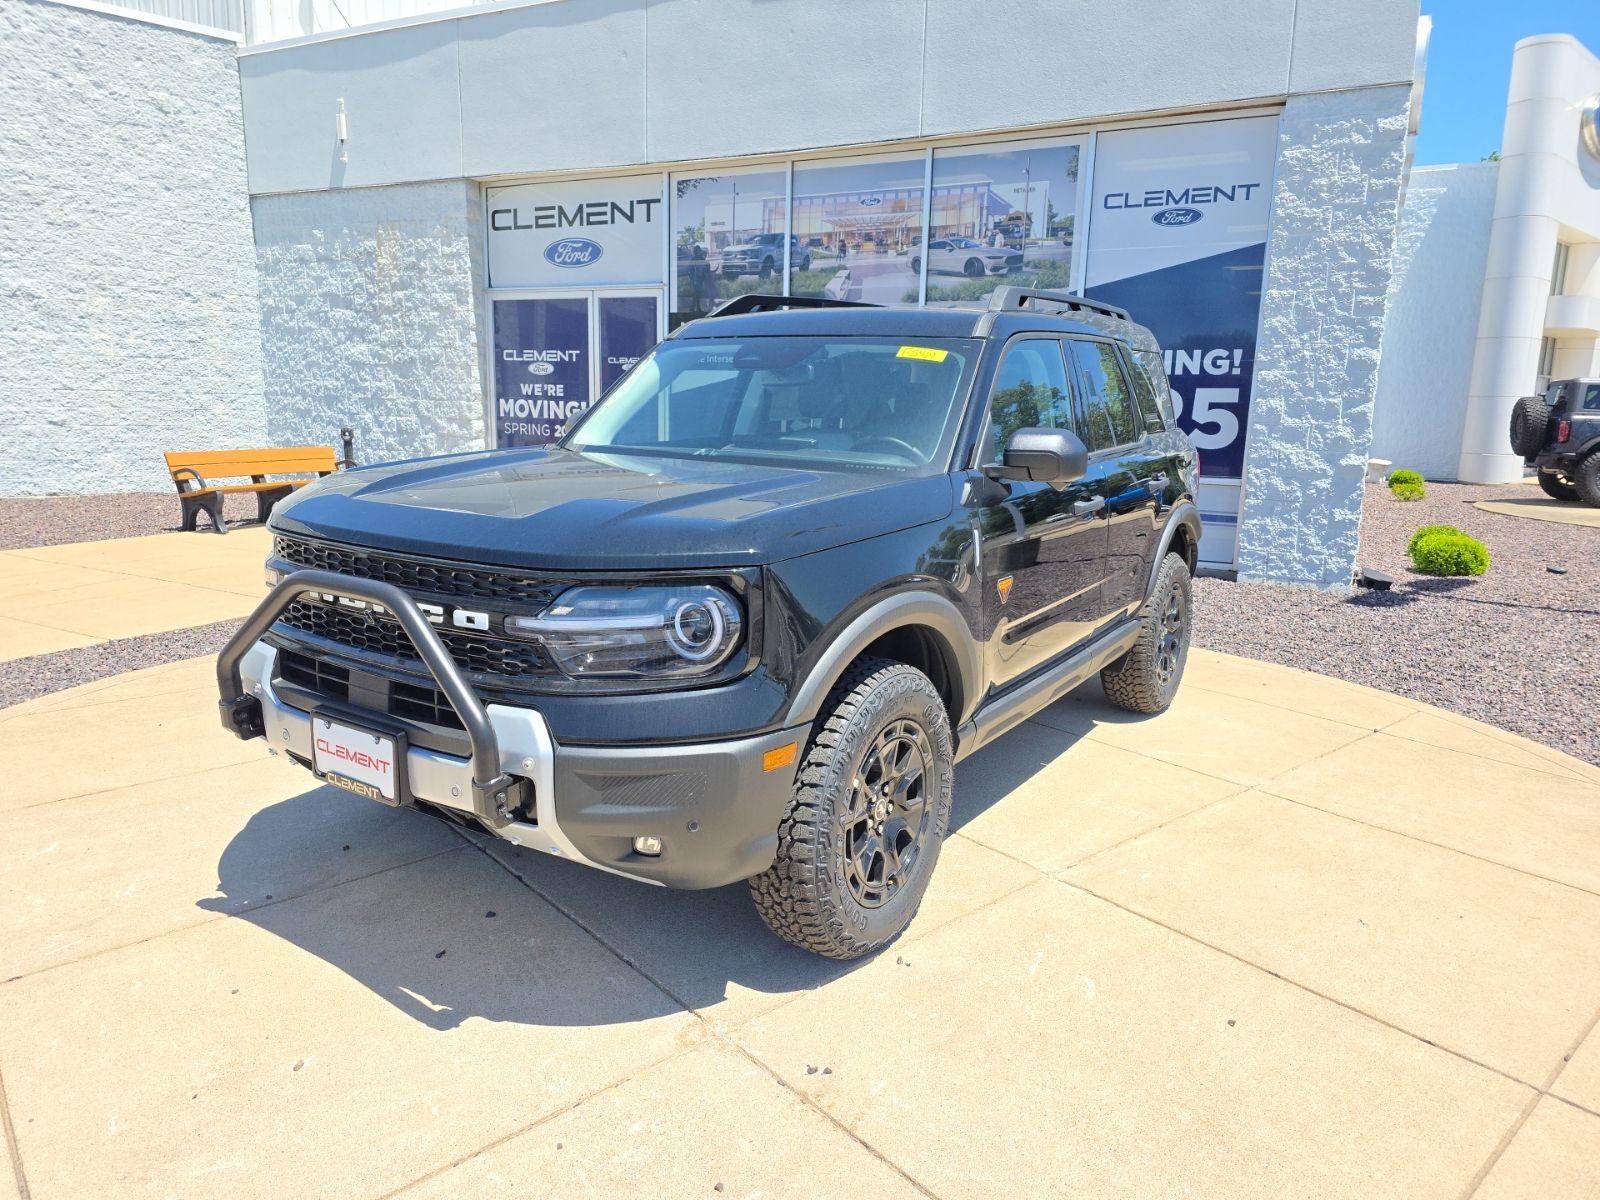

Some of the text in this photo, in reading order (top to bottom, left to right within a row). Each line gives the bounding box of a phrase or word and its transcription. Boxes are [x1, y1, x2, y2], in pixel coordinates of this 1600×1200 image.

[1103, 184, 1260, 209] CLEMENT
[491, 199, 661, 231] CLEMENT
[1161, 210, 1193, 224] Ford
[554, 242, 592, 263] Ford
[503, 350, 580, 362] CLEMENT
[608, 356, 640, 364] CLEME
[1160, 348, 1243, 375] ING!
[520, 384, 564, 396] WE'RE
[504, 423, 550, 436] SPRING
[317, 738, 390, 774] CLEMENT
[328, 773, 379, 799] CLEMENT
